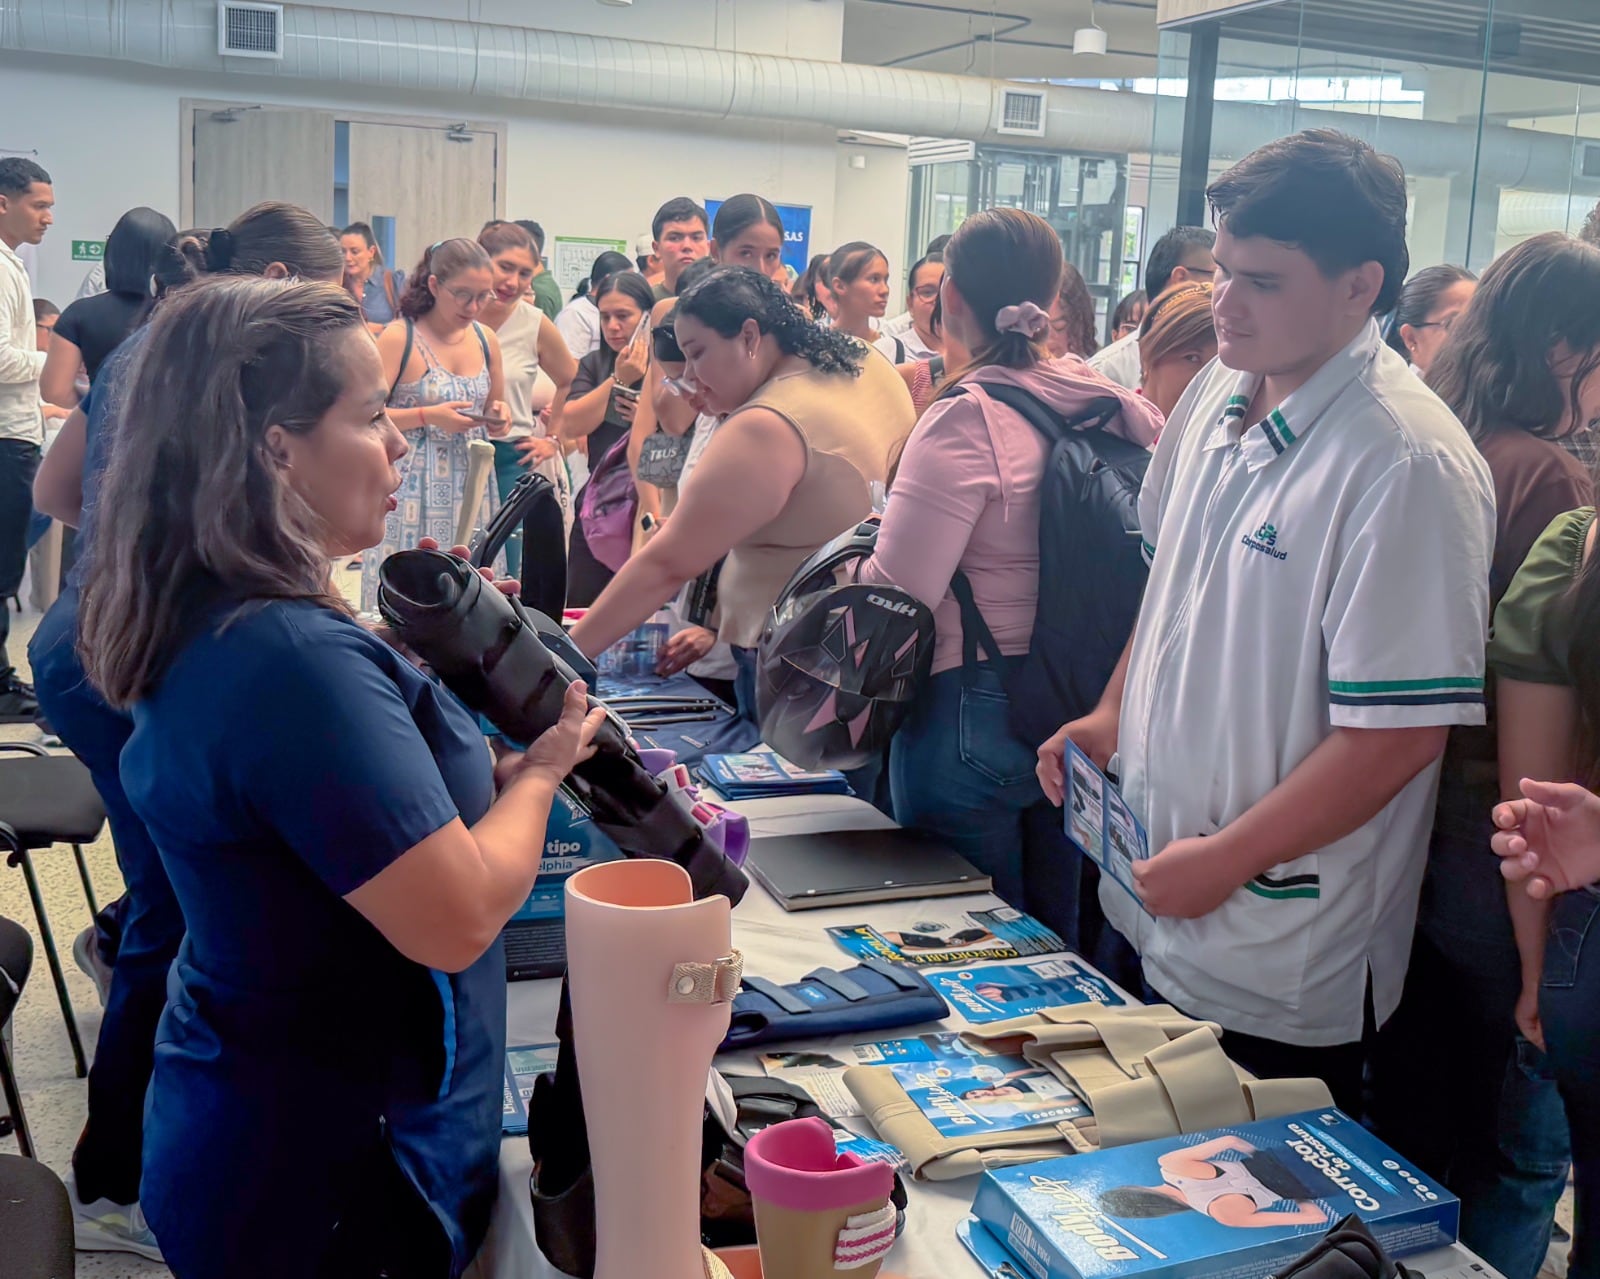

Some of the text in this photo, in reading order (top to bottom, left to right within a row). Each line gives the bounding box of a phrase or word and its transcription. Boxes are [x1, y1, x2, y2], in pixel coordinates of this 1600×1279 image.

[1241, 534, 1288, 561] Corposalud
[866, 593, 918, 617] HRO
[546, 839, 581, 856] tipo
[1287, 1122, 1352, 1171] de Postura
[1284, 1138, 1381, 1211] Corrector
